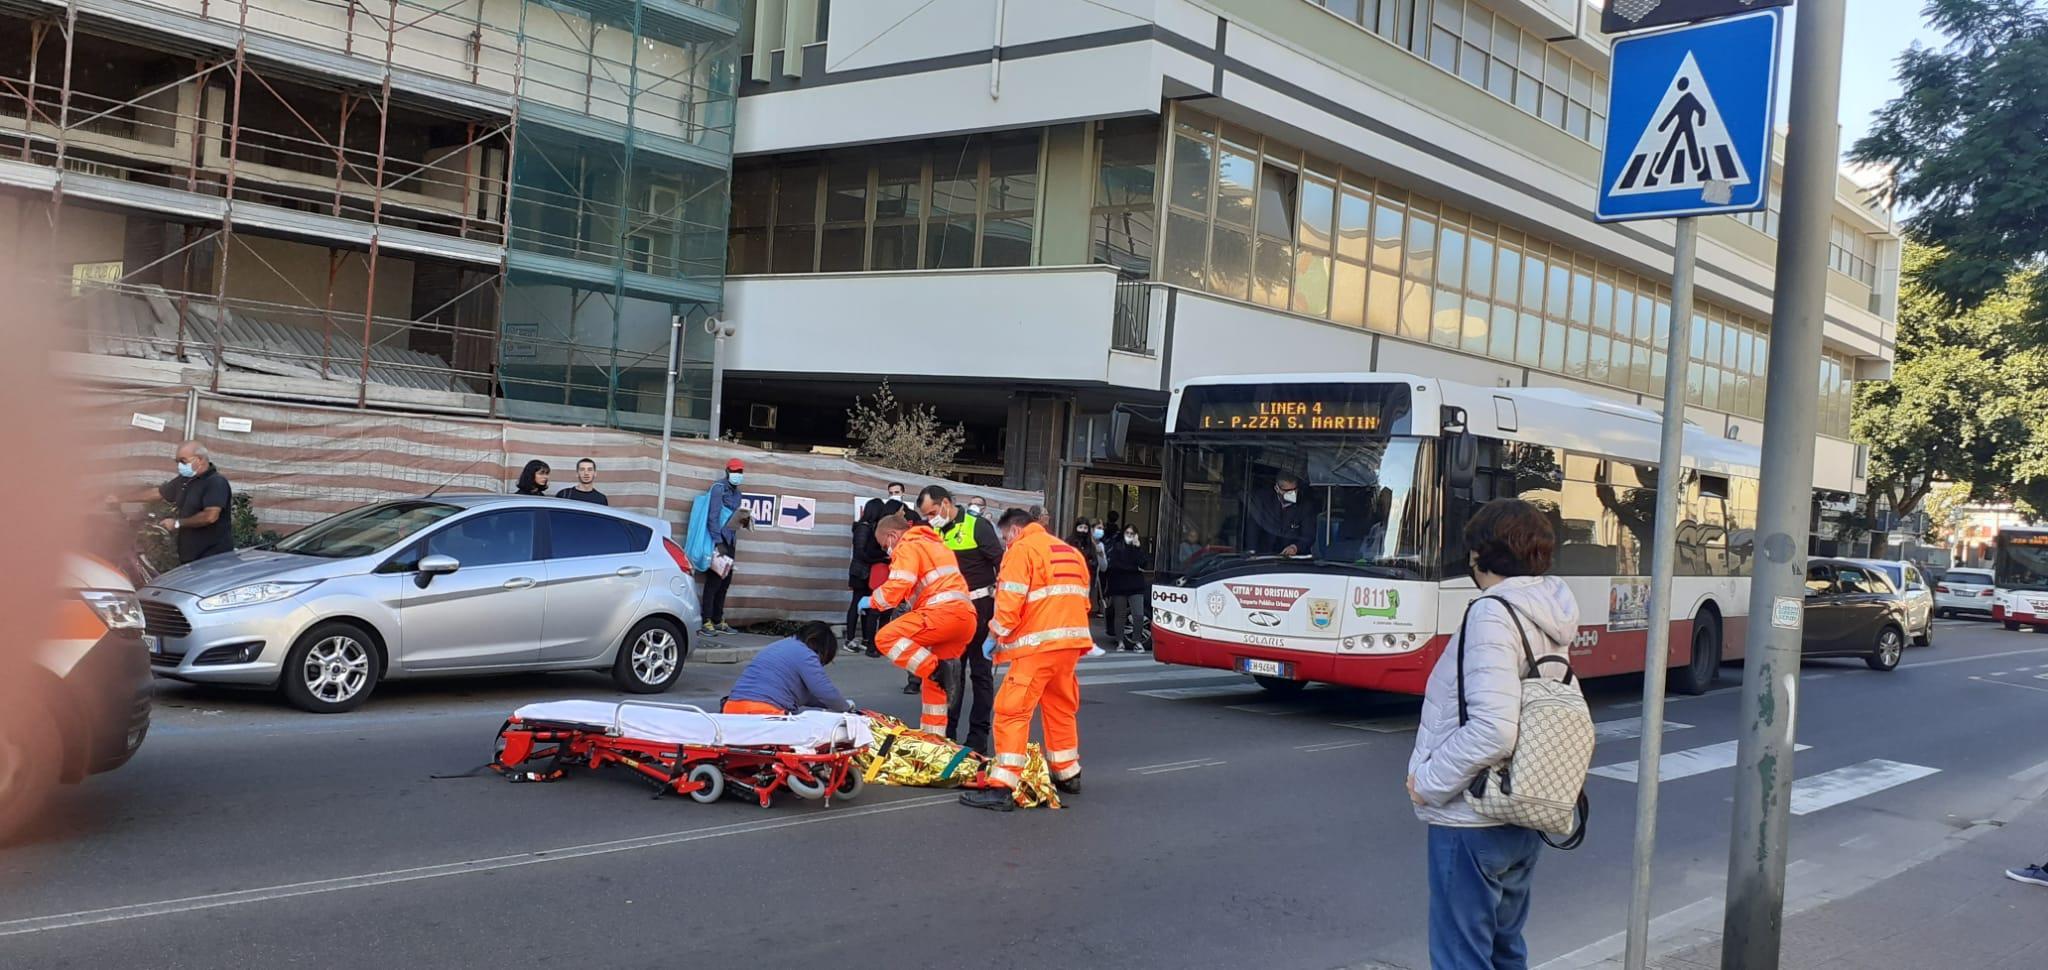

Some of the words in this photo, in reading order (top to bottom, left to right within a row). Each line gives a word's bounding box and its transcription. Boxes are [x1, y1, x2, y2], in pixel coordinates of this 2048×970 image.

[1260, 402, 1306, 415] LINEA
[1312, 402, 1322, 414] 4
[1231, 416, 1280, 429] P.ZZA
[1287, 416, 1304, 429] S.
[1312, 416, 1380, 430] MARTIN
[1254, 587, 1263, 597] DI
[1264, 587, 1300, 599] ORISTANO
[1354, 586, 1385, 608] 0811
[1243, 634, 1285, 647] SOLARIS
